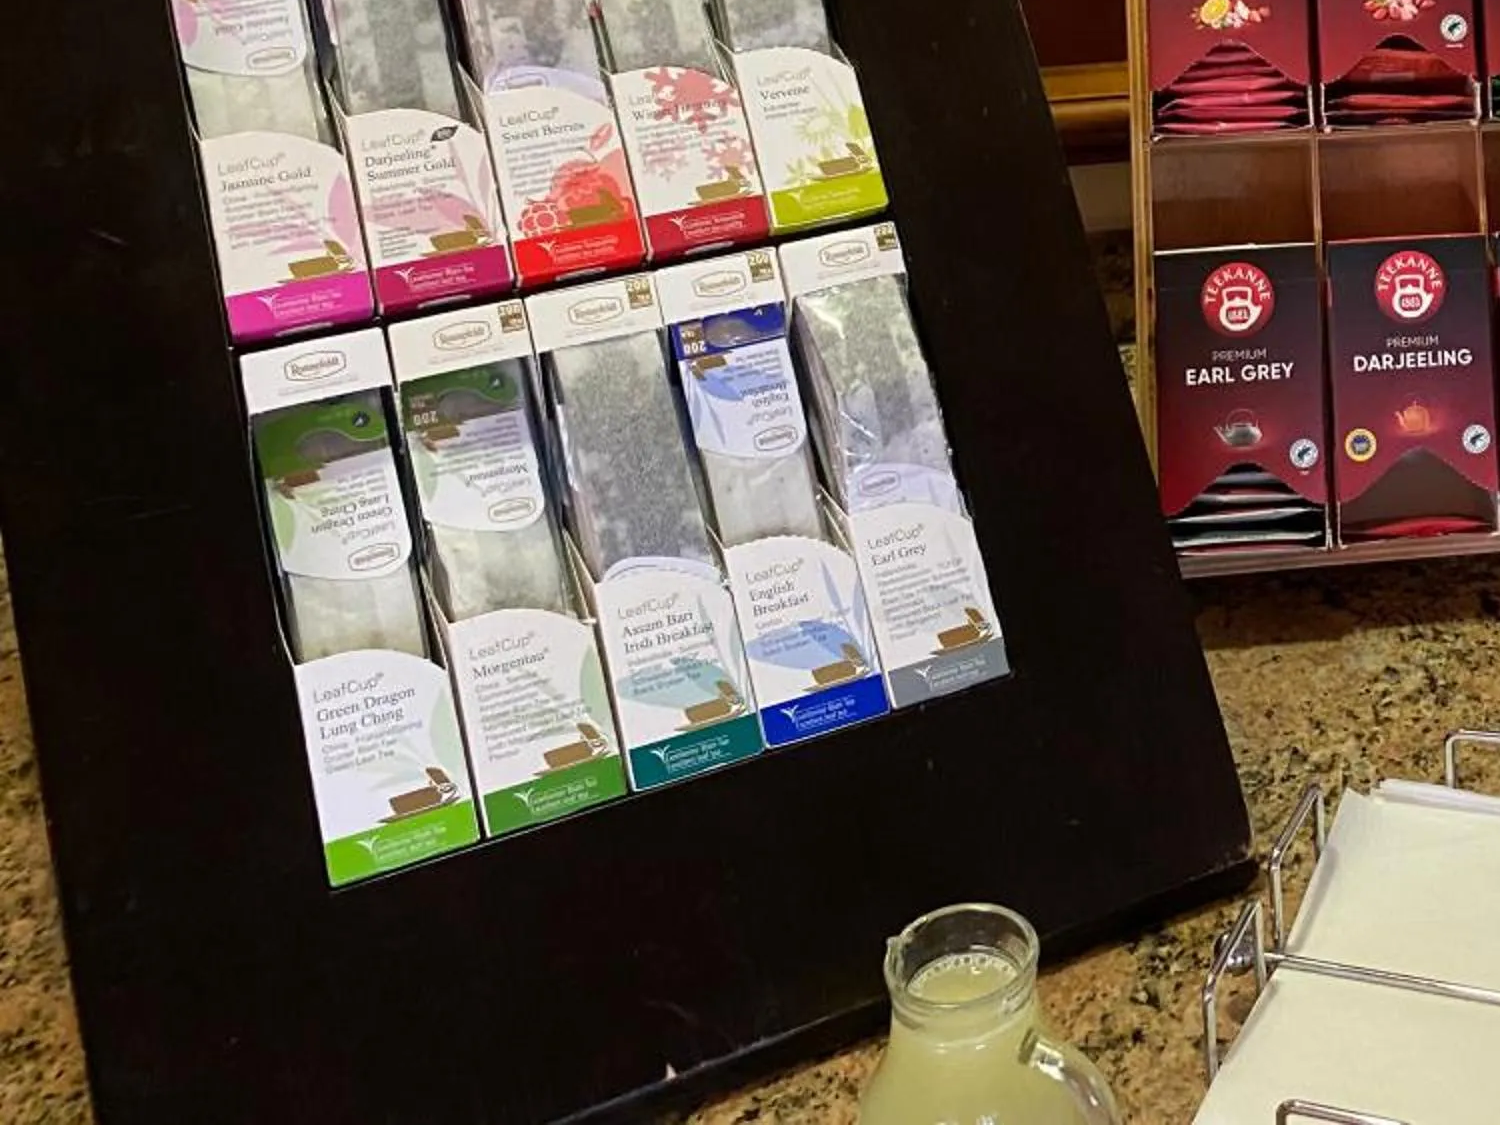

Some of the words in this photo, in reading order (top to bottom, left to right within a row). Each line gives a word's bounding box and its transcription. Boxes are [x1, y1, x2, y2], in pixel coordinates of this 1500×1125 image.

[501, 129, 540, 144] Sweet
[219, 175, 276, 192] Jasmine
[277, 166, 312, 181] Gold
[367, 165, 421, 182] Summer
[423, 157, 457, 172] Gold
[1377, 254, 1443, 291] TEEKANNE
[1205, 268, 1272, 304] TEEKANNE
[1386, 334, 1440, 348] PREMIUM
[1211, 348, 1268, 361] PREMIUM
[1353, 348, 1473, 373] DARJEELING
[1186, 365, 1235, 386] EARL
[1241, 362, 1294, 382] GREY
[871, 551, 897, 566] Earl
[898, 543, 927, 560] Grey
[749, 580, 795, 602] English
[753, 592, 810, 618] Breakfast
[623, 620, 663, 639] Assam
[624, 637, 654, 655] Irish
[657, 621, 715, 646] Breakfast
[316, 703, 359, 723] Green
[364, 686, 416, 710] Dragon
[319, 720, 358, 741] Lung
[361, 706, 404, 727] Ching
